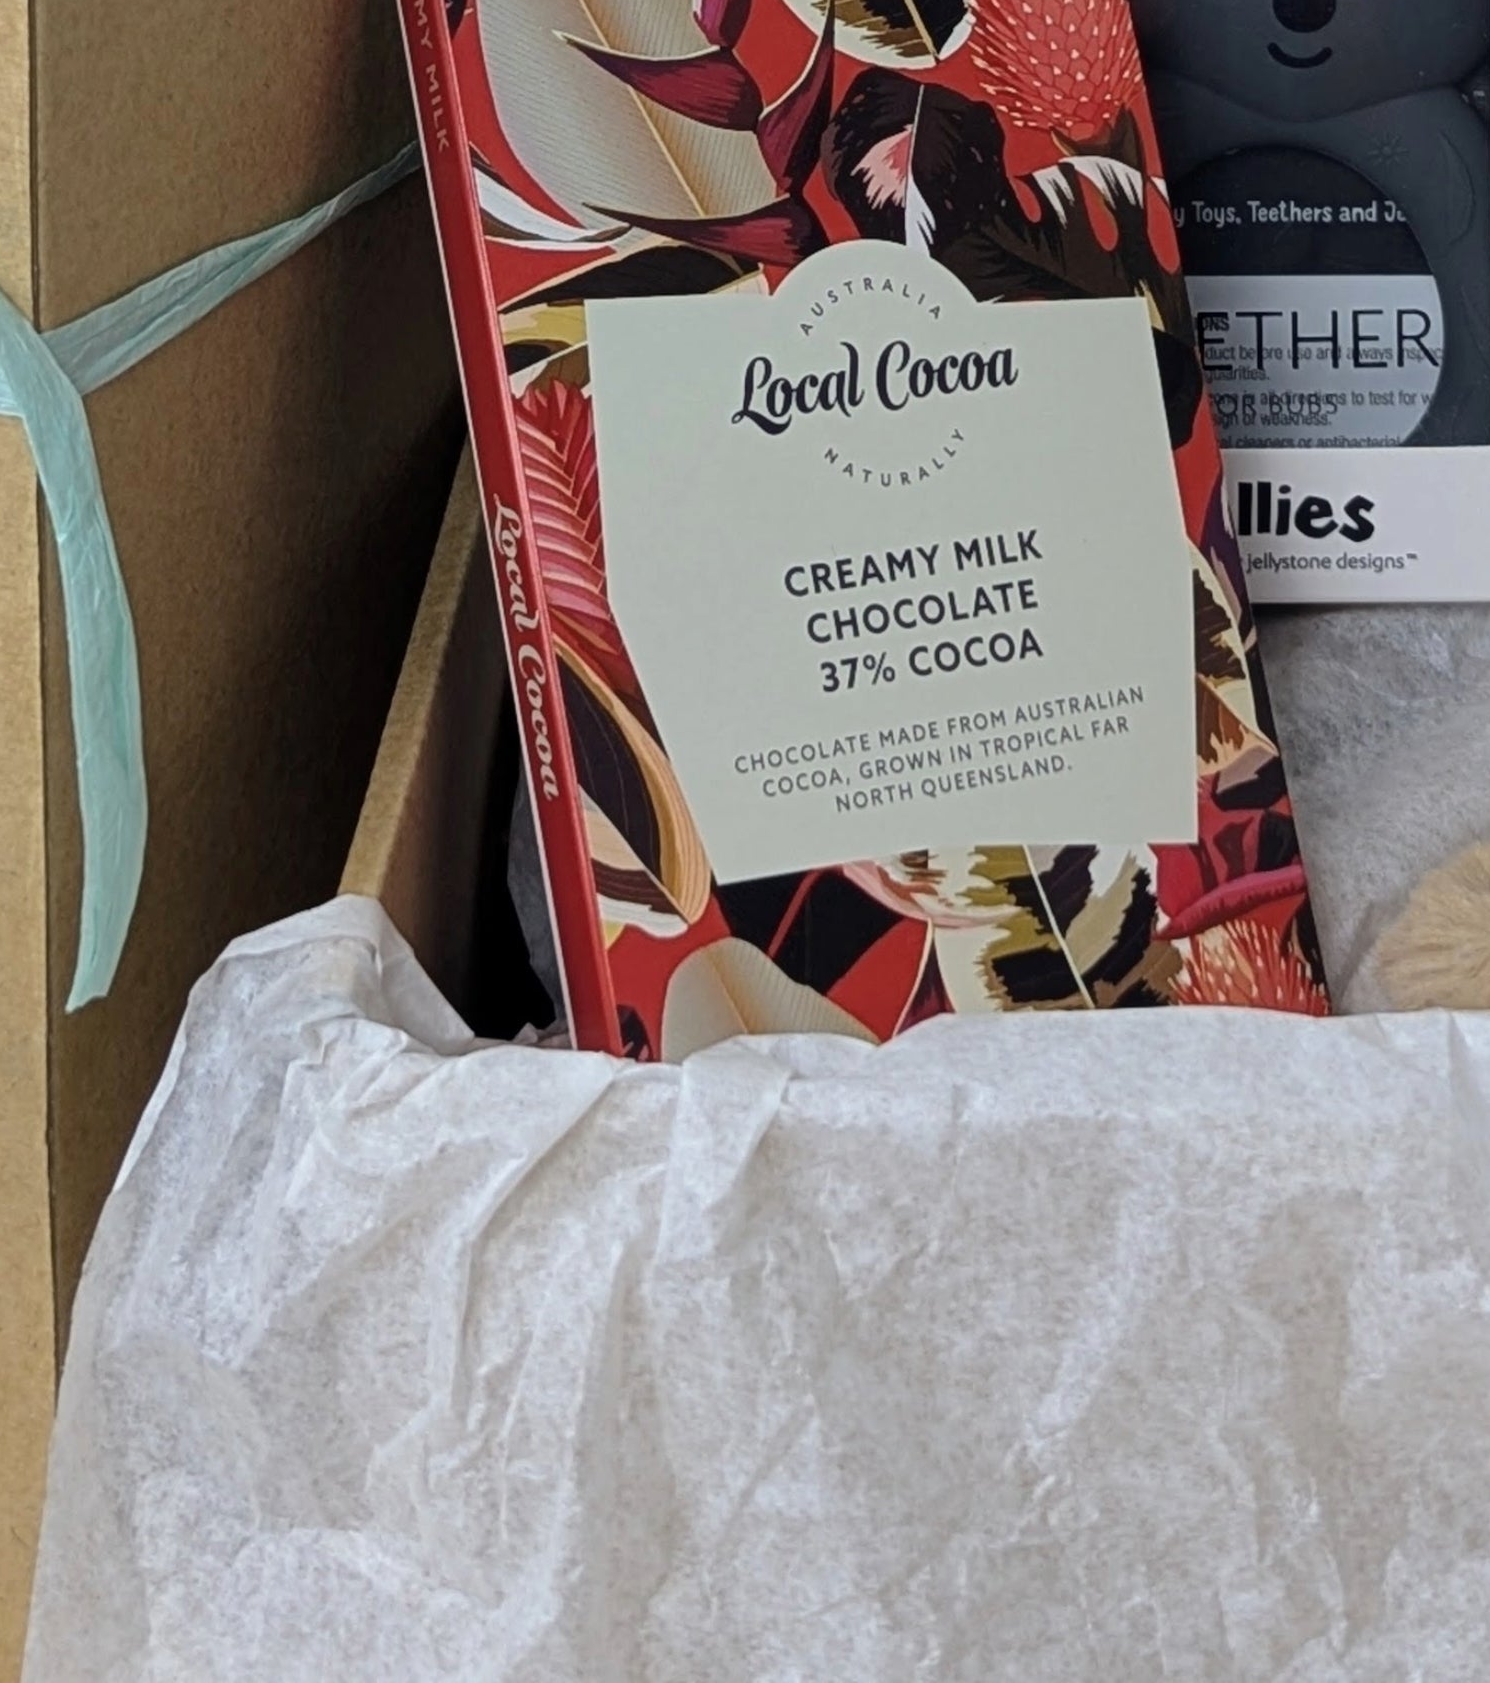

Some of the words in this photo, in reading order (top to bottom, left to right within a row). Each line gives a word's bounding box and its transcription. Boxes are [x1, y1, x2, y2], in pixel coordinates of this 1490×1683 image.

[426, 63, 451, 152] MILK
[1246, 200, 1333, 223] Teethers
[1338, 200, 1378, 223] and
[800, 277, 942, 336] AUSTRALIA
[1239, 345, 1283, 360] beore
[731, 341, 865, 435] Local
[876, 340, 1019, 411] Cocoa
[824, 428, 964, 487] NATURALLY
[784, 543, 939, 597] CREAMY
[953, 529, 1043, 571] MILK
[1246, 552, 1332, 574] jellystone
[807, 578, 1039, 644] CHOCOLATE
[493, 493, 541, 633] Local
[518, 643, 560, 802] Cocoa
[820, 651, 897, 693] 37%
[908, 628, 1044, 677] COCOA
[733, 733, 872, 775] CHOCOLATE
[878, 721, 941, 748] MADE
[947, 709, 1008, 736] FROM
[1013, 685, 1145, 725] AUSTRALIAN
[762, 767, 852, 799] COCOA,
[858, 742, 943, 780] GROWN
[949, 742, 973, 764] IN
[980, 724, 1085, 758] TROPICAL
[1091, 715, 1131, 739] FAR
[835, 783, 914, 814] NORTH
[920, 753, 1074, 799] QUEENSLAND.
